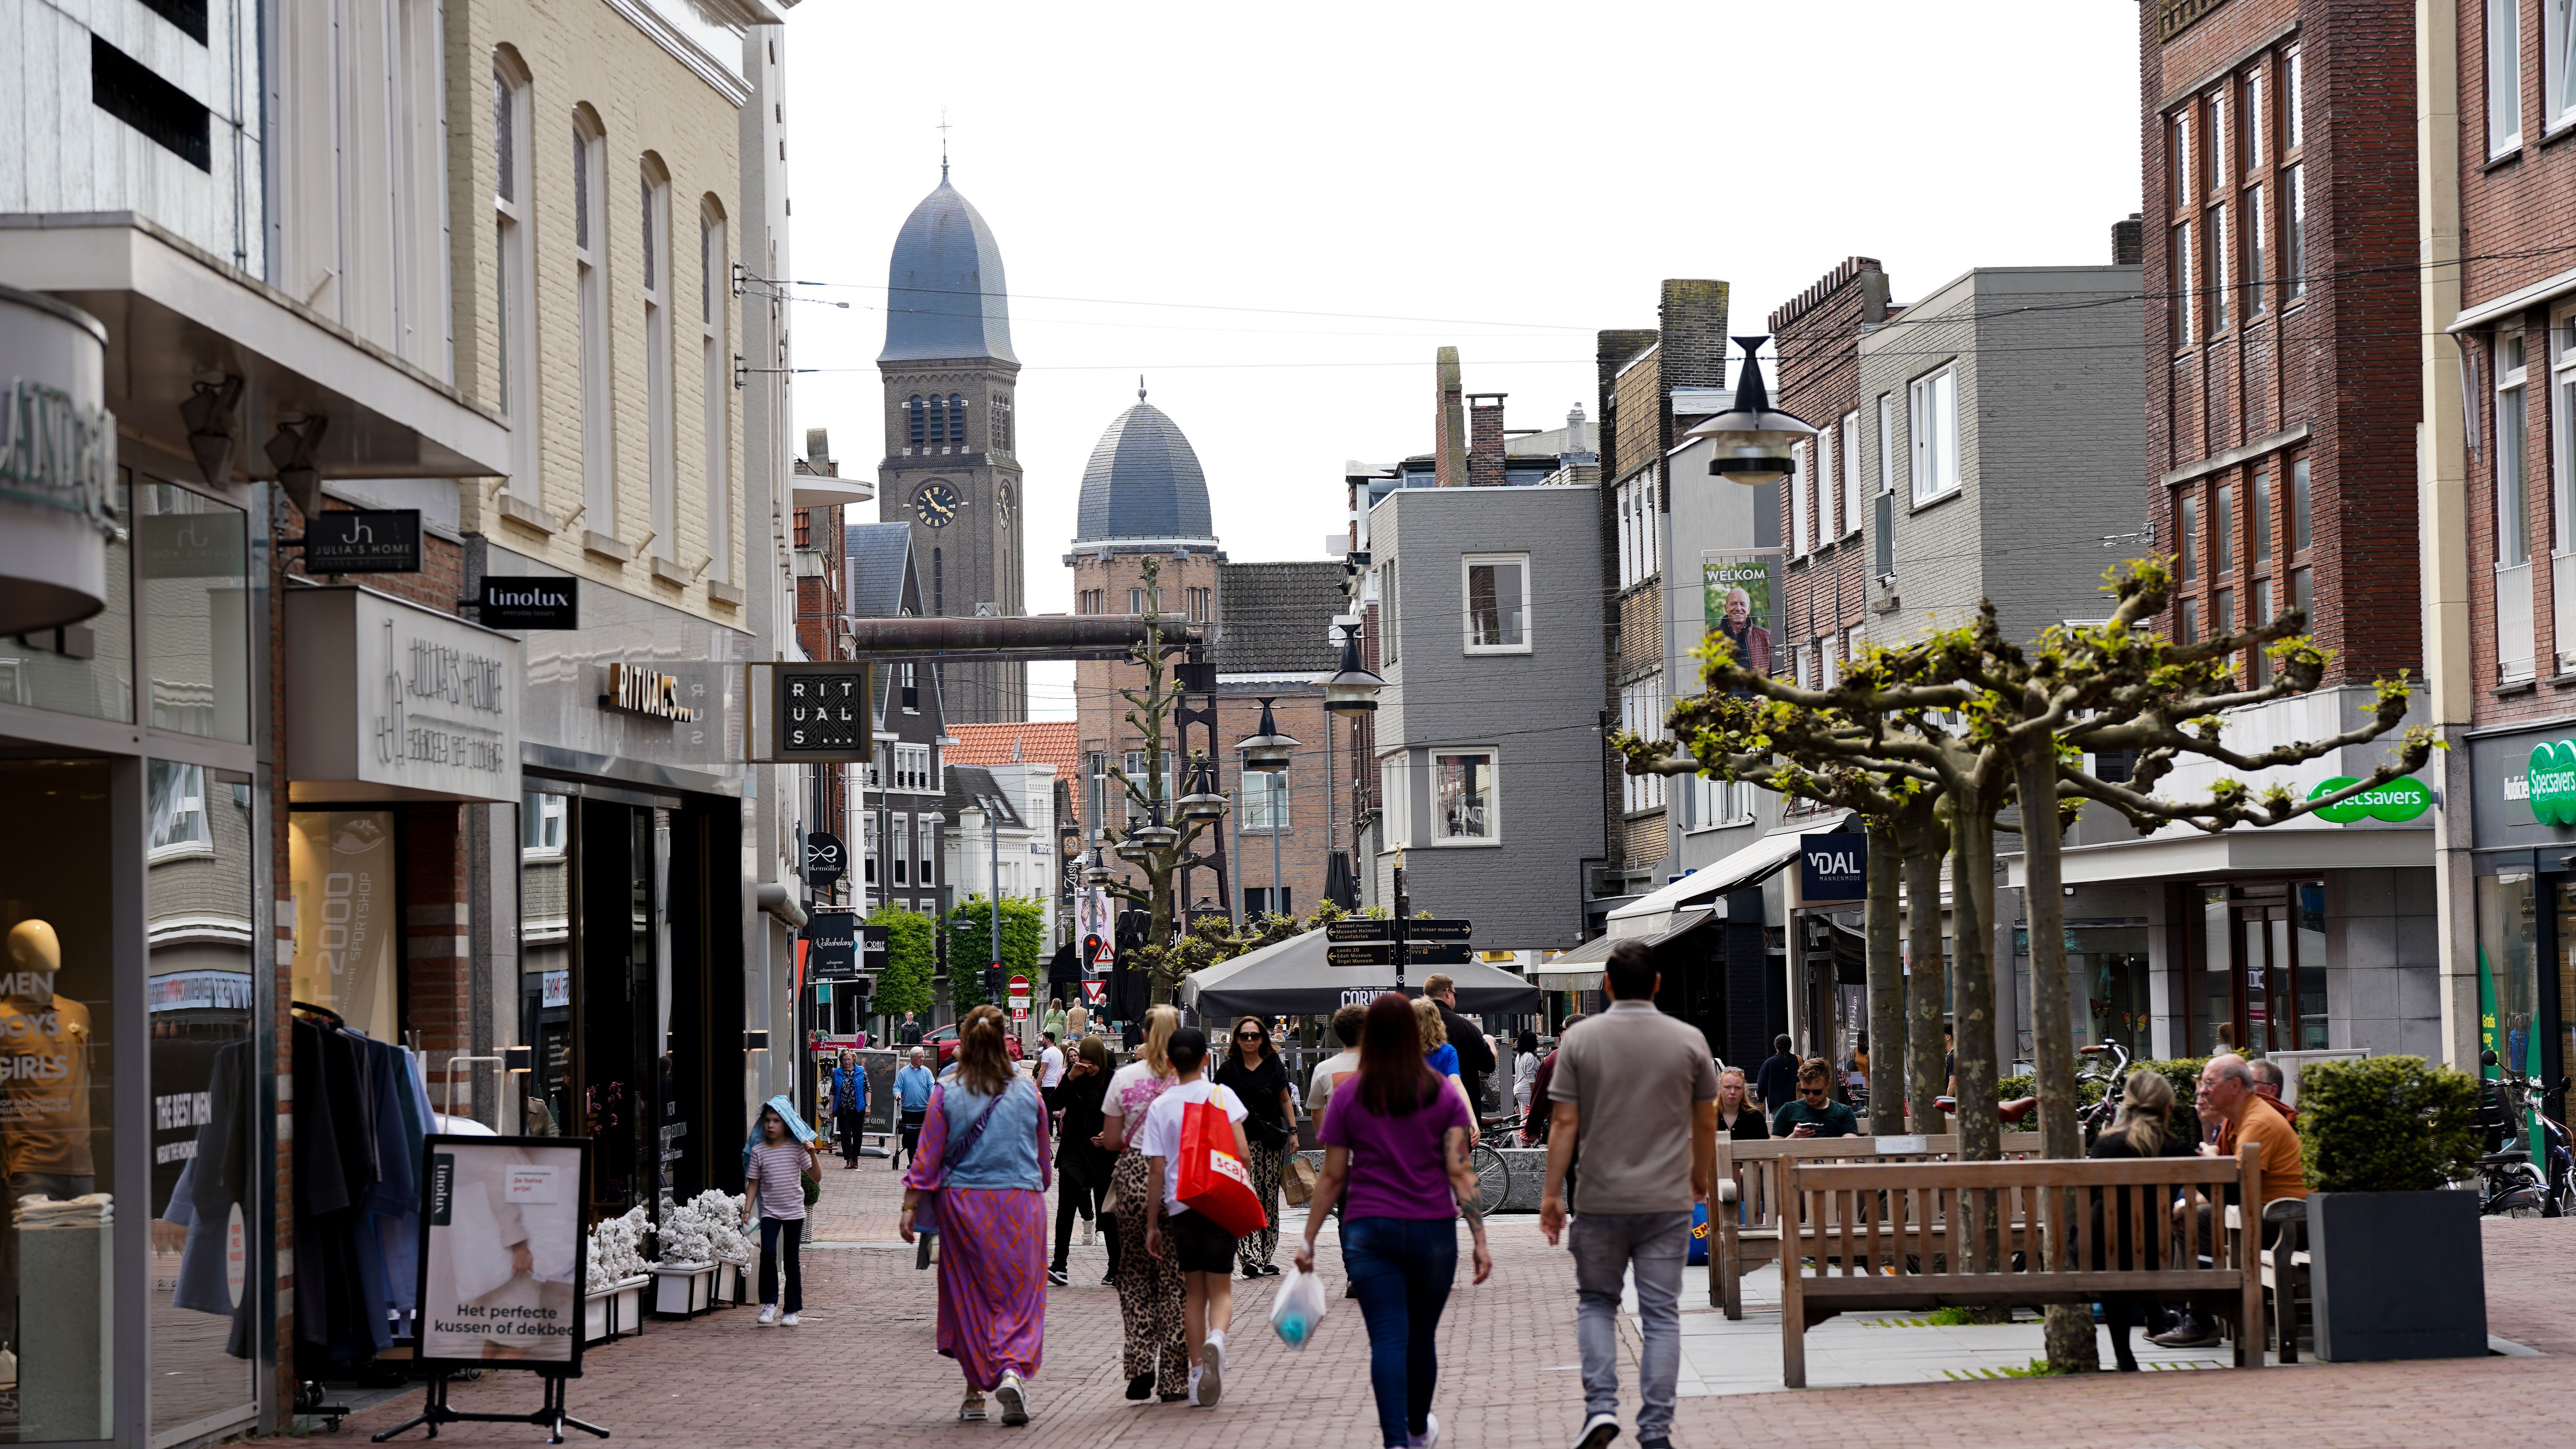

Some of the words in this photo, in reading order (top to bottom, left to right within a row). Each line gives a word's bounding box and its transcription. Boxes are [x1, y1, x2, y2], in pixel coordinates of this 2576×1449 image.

[314, 545, 365, 555] JULIA'S
[371, 543, 411, 554] HOME
[1707, 569, 1765, 581] WELKOM
[2504, 775, 2530, 800] Audicie
[2531, 770, 2576, 800] Specsavers
[315, 872, 354, 975] 2000
[350, 872, 371, 961] SPORTSHOP
[863, 940, 885, 949] LORALE
[1341, 990, 1396, 1009] CORN
[2482, 1012, 2495, 1028] Gratis
[1694, 1225, 1708, 1237] SM
[457, 1303, 486, 1316] Het
[490, 1306, 557, 1320] perfecte
[434, 1319, 491, 1334] kussen
[496, 1322, 514, 1335] of
